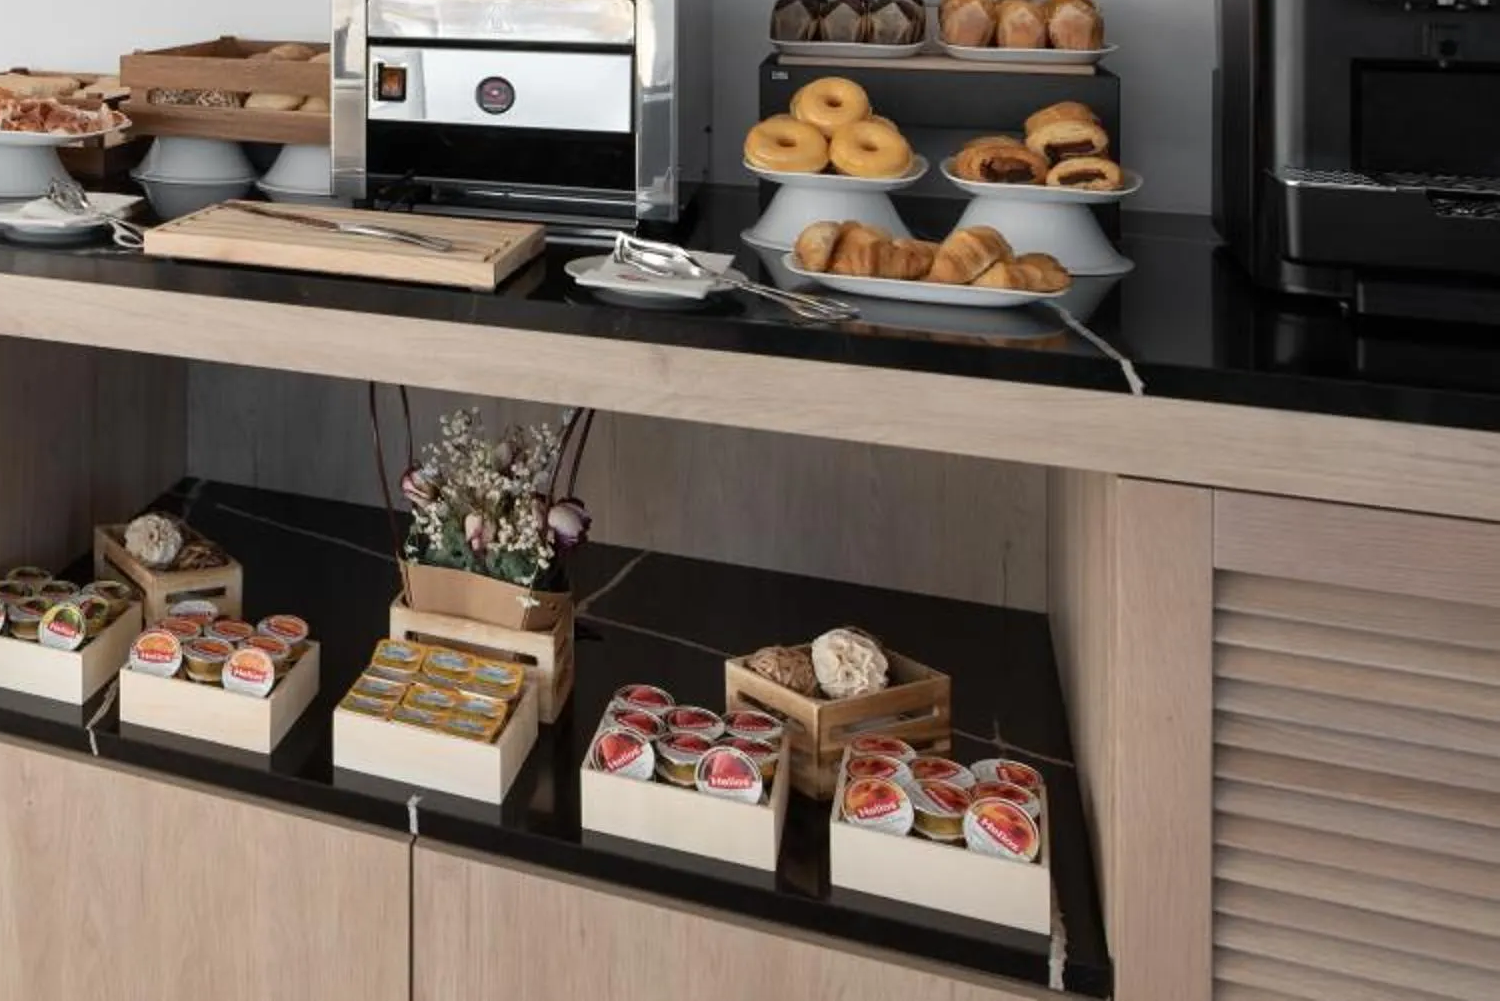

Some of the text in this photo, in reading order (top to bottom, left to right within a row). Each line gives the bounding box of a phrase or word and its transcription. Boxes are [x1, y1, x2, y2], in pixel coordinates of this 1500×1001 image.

[607, 744, 642, 770] Helios
[709, 774, 751, 788] Helios
[857, 801, 898, 818] Helios
[980, 817, 1020, 851] Helios
